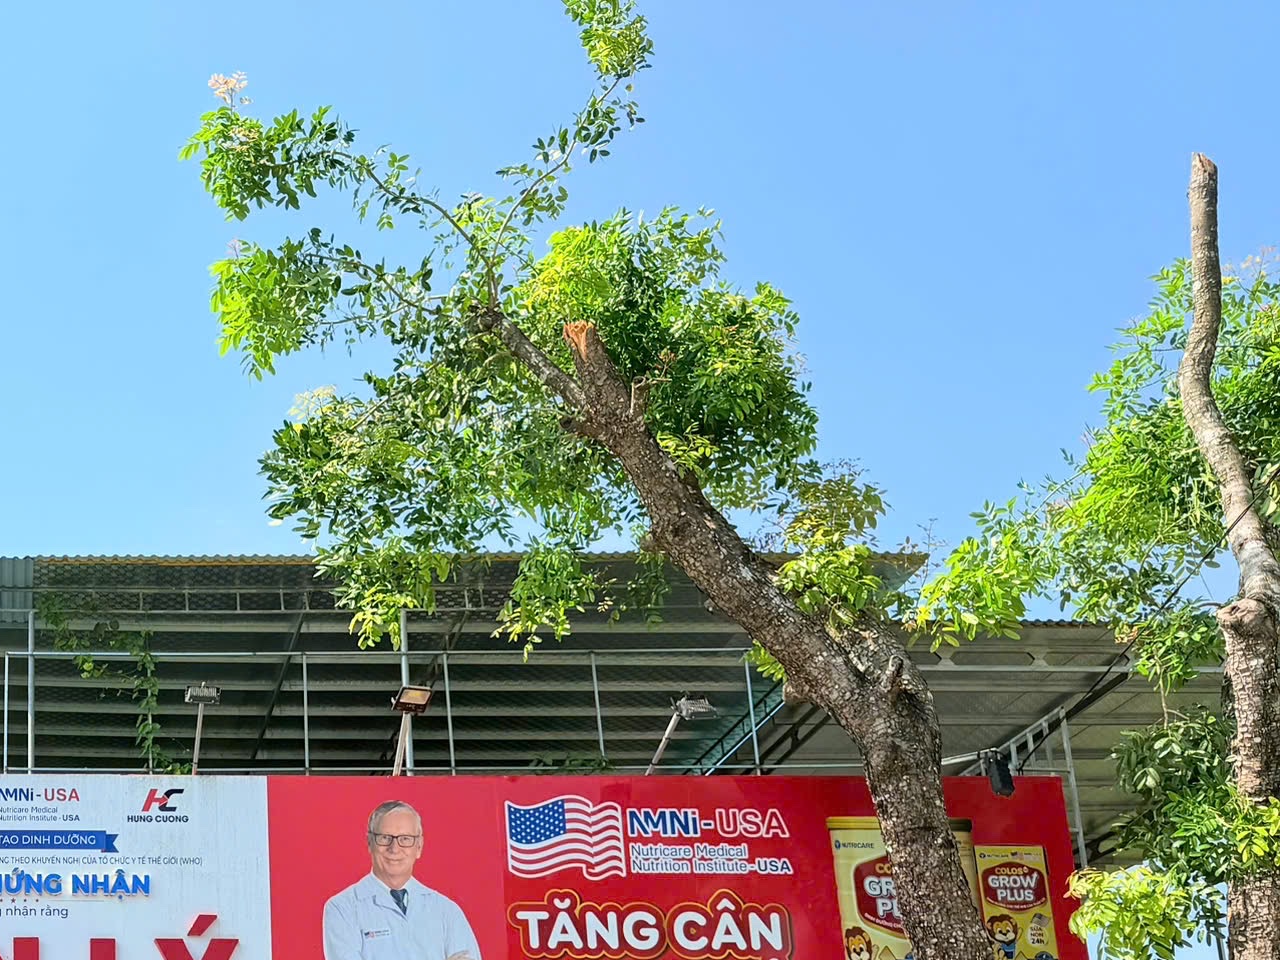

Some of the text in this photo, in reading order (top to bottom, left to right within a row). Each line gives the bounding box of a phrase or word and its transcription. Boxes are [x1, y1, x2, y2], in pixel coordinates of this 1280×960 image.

[31, 806, 58, 814] Medical
[127, 815, 189, 823] HUNG CUONG
[22, 835, 51, 845] DINH
[53, 832, 96, 845] DƯỠNG
[71, 868, 150, 900] NHẬN
[7, 904, 37, 918] nhận
[40, 904, 69, 919] rằng
[516, 898, 783, 951] TĂNG CÂN
